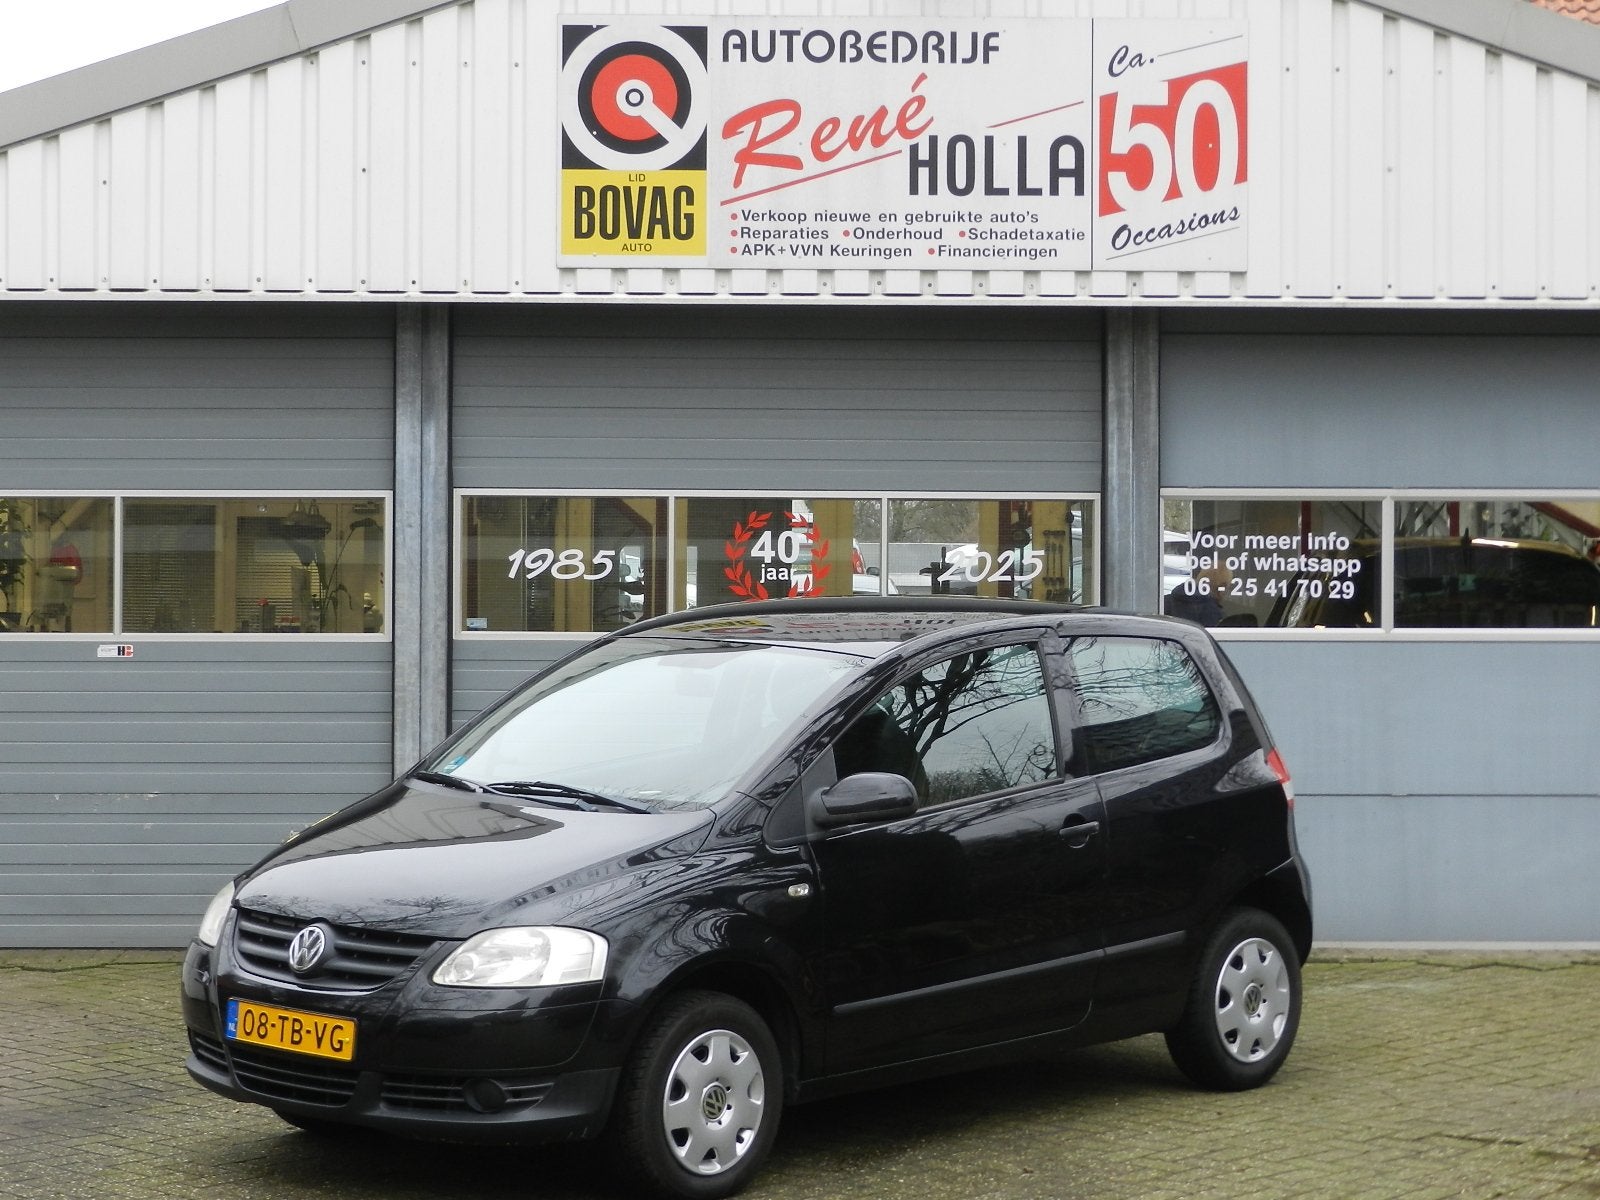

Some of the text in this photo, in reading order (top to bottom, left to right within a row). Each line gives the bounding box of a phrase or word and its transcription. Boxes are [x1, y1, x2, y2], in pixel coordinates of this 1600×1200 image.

[722, 29, 1000, 64] AUTOBEDRIJF
[1107, 45, 1155, 78] Ca.
[721, 72, 934, 189] René
[1107, 79, 1240, 212] 50
[628, 173, 646, 182] LID
[908, 134, 1085, 197] HOLLA
[574, 184, 695, 241] BOVAG
[741, 210, 1039, 226] Verkoop nieuwe en gebruikte auto's
[1111, 206, 1240, 251] Occasions
[621, 243, 653, 252] AUTO
[740, 227, 1086, 242] Reparaties Onderhoud Schadetaxatie
[830, 245, 913, 259] Keuringen
[938, 245, 1058, 260] Financieringen
[750, 530, 800, 564] 40
[1186, 531, 1238, 550] Voor
[1245, 534, 1301, 550] meer
[508, 548, 616, 580] 1985
[760, 564, 797, 584] jaar
[937, 549, 1045, 582] 2025
[1186, 551, 1362, 578] bel of whatsapp
[1183, 577, 1211, 597] 06
[1230, 577, 1258, 597] 25
[1263, 578, 1289, 598] 41
[1296, 579, 1323, 598] 70
[1328, 580, 1355, 600] 29
[242, 1009, 344, 1053] 08-TB-VG
